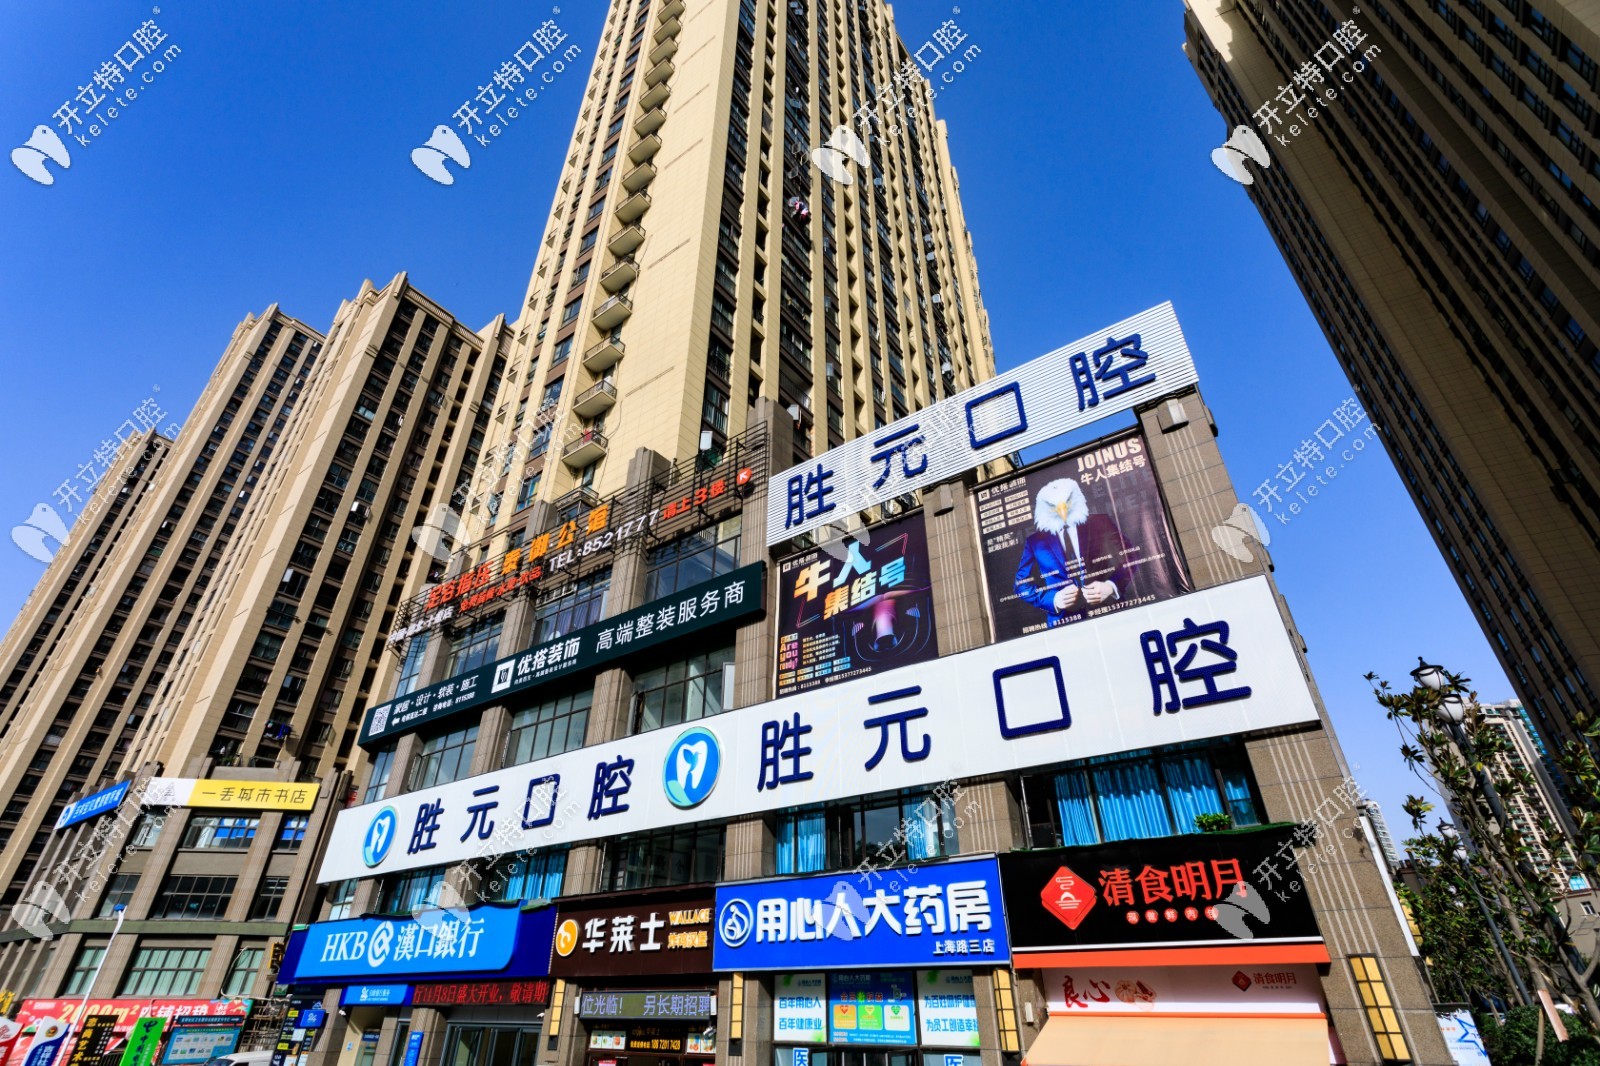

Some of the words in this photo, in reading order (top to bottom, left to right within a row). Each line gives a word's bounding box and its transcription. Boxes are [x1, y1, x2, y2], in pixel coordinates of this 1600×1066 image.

[785, 333, 1156, 529] 胜元口腔
[1076, 437, 1142, 473] JOINUS
[1080, 455, 1146, 486] 牛人集结号
[662, 478, 727, 520] 请上3楼
[549, 509, 660, 572] TEL:8521777
[793, 540, 872, 602] 牛人
[823, 557, 906, 620] 集结号
[595, 580, 746, 654] 高端整装服务商
[757, 617, 1252, 792] 胜元口腔
[407, 754, 635, 855] 胜元口腔
[1098, 858, 1247, 907] 清食明月
[582, 913, 665, 953] 华莱士
[668, 908, 710, 926] WALLACE
[756, 880, 992, 943] 用心人大药房
[320, 931, 369, 962] HKB
[393, 917, 484, 961] 漢口銀行
[933, 939, 995, 956] 上海路三店
[779, 996, 821, 1009] 百年用心人
[1062, 975, 1110, 1009] 良心
[1252, 972, 1297, 985] 清食明月
[779, 1017, 822, 1030] 百年健康业
